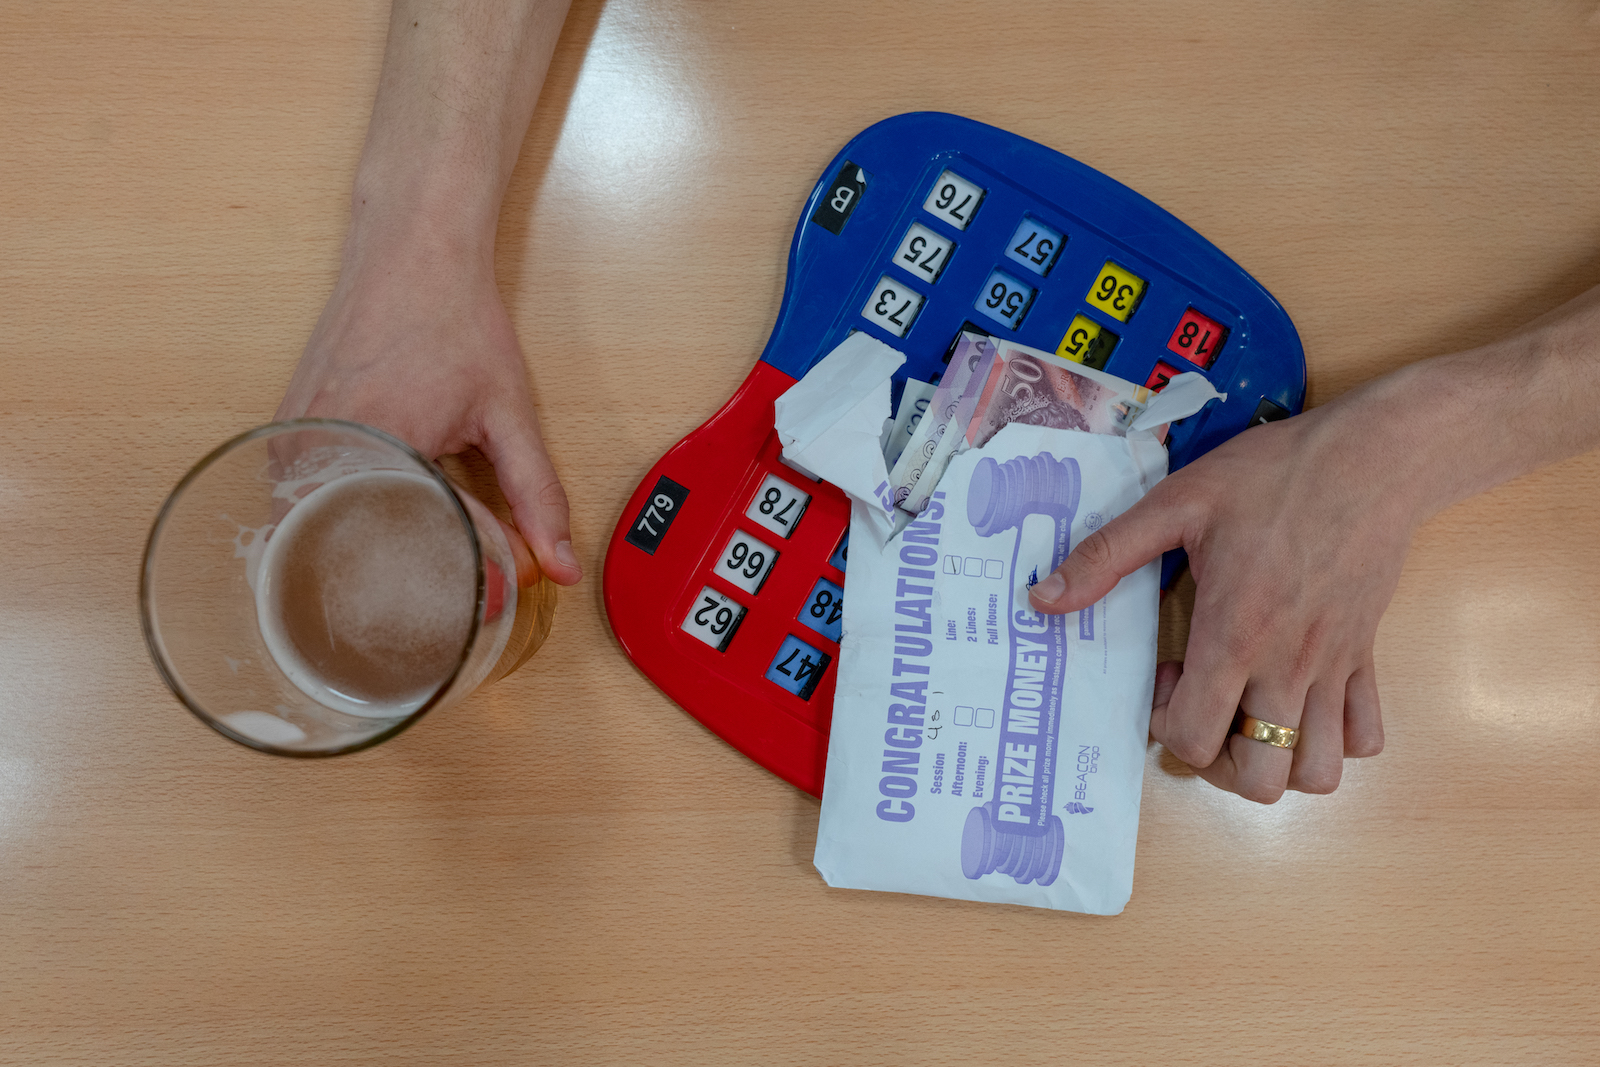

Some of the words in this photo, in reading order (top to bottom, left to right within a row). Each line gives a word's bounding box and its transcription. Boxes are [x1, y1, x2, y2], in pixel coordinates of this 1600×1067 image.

[830, 186, 855, 213] B
[935, 184, 973, 221] 76
[903, 236, 942, 274] 75
[1014, 232, 1054, 266] 57
[875, 289, 912, 327] 73
[985, 282, 1024, 319] 56
[1096, 275, 1134, 311] 36
[1178, 321, 1211, 356] 18
[1001, 358, 1042, 407] 50
[637, 493, 675, 537] 779
[759, 487, 797, 526] 78
[1059, 517, 1067, 532] club.
[726, 542, 765, 579] 66
[1057, 544, 1065, 555] left
[694, 596, 733, 635] 62
[810, 590, 843, 625] 48
[967, 607, 977, 632] Lines:
[988, 593, 998, 620] House:
[946, 620, 957, 641] Line:
[967, 634, 978, 643] 2
[988, 621, 999, 645] Full
[1053, 626, 1061, 634] be
[1054, 634, 1062, 645] not
[776, 648, 818, 682] 47
[1052, 658, 1062, 686] mistakes
[1007, 637, 1048, 736] MONEY
[1051, 687, 1058, 696] as
[1046, 696, 1058, 734] immediately
[1046, 735, 1054, 757] money
[1087, 745, 1101, 774] bingo
[930, 753, 945, 794] Session
[951, 741, 967, 797] Afternoon:
[972, 755, 990, 798] Evening:
[1043, 758, 1051, 774] prize
[1074, 745, 1091, 800] BEACON
[998, 742, 1038, 825] PRIZE
[1040, 784, 1049, 804] check
[1037, 805, 1047, 826] Please
